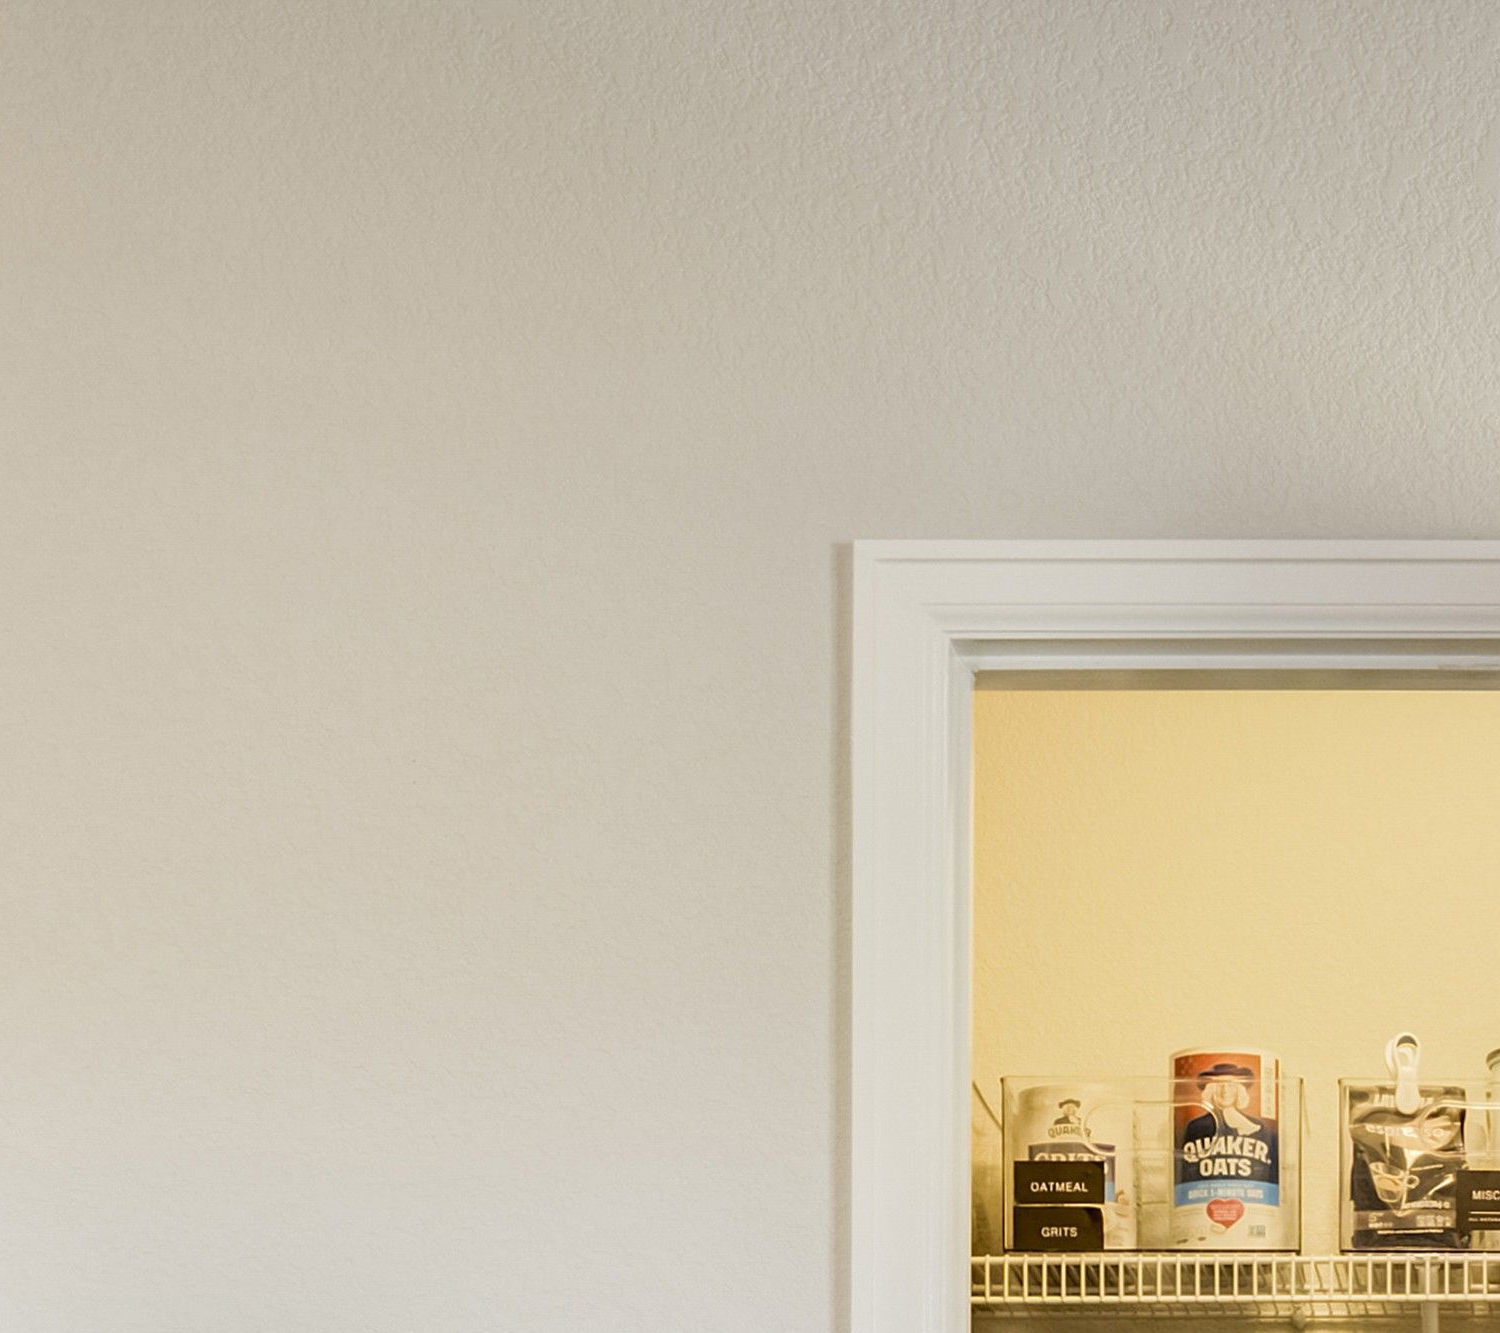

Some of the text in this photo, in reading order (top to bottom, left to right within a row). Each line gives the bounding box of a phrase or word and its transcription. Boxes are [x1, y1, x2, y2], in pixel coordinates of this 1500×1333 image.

[1183, 1135, 1269, 1164] QUAKER
[1199, 1157, 1252, 1177] OATS
[1030, 1181, 1088, 1193] OATMEAL
[1472, 1190, 1500, 1200] MISC
[1041, 1226, 1078, 1237] GRITS
